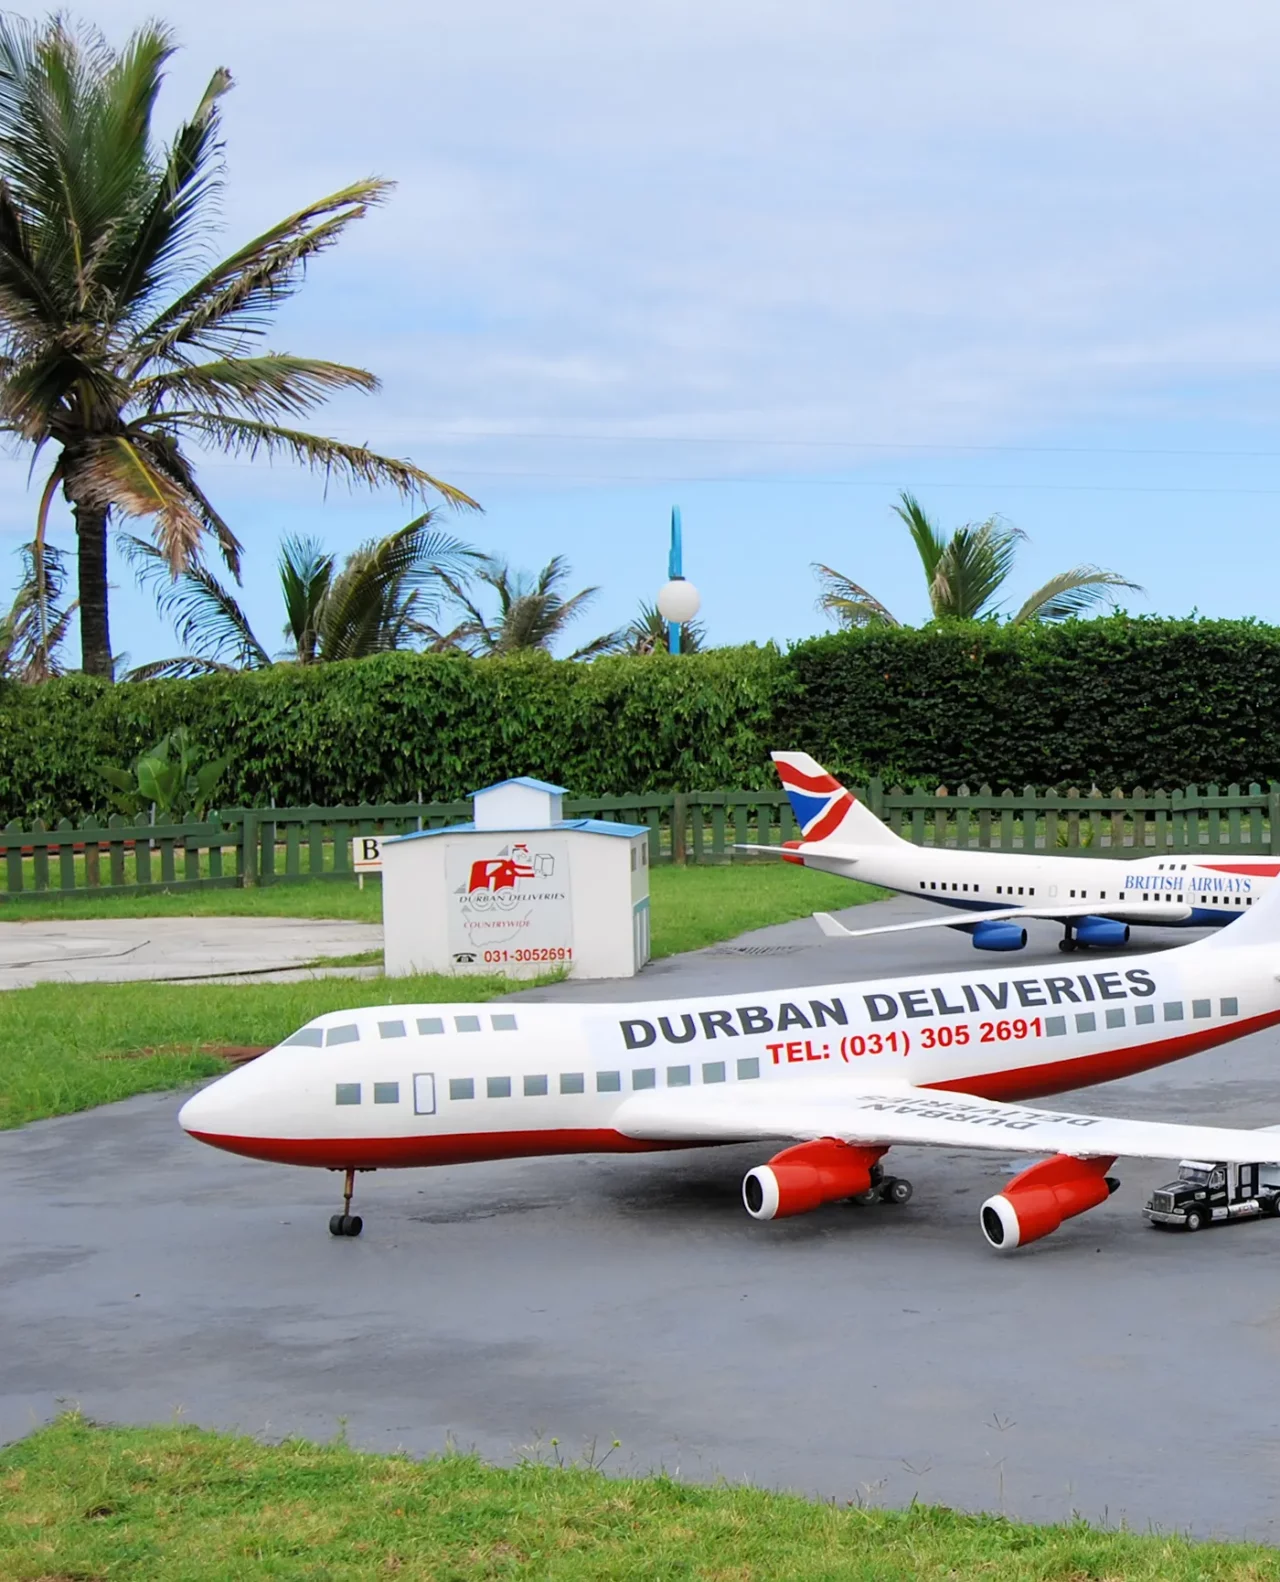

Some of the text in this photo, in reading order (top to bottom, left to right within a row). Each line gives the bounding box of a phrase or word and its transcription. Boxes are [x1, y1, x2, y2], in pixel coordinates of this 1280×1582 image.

[1125, 875, 1252, 893] BRITISH AIRWAYS
[459, 893, 565, 903] DURBAN DELIVERIES
[464, 920, 530, 929] COUNTRYWIDE
[484, 947, 573, 963] 031-3052691
[619, 968, 1157, 1050] DURBAN DELIVERIES
[766, 1017, 1044, 1066] TEL: (031) 305 2691
